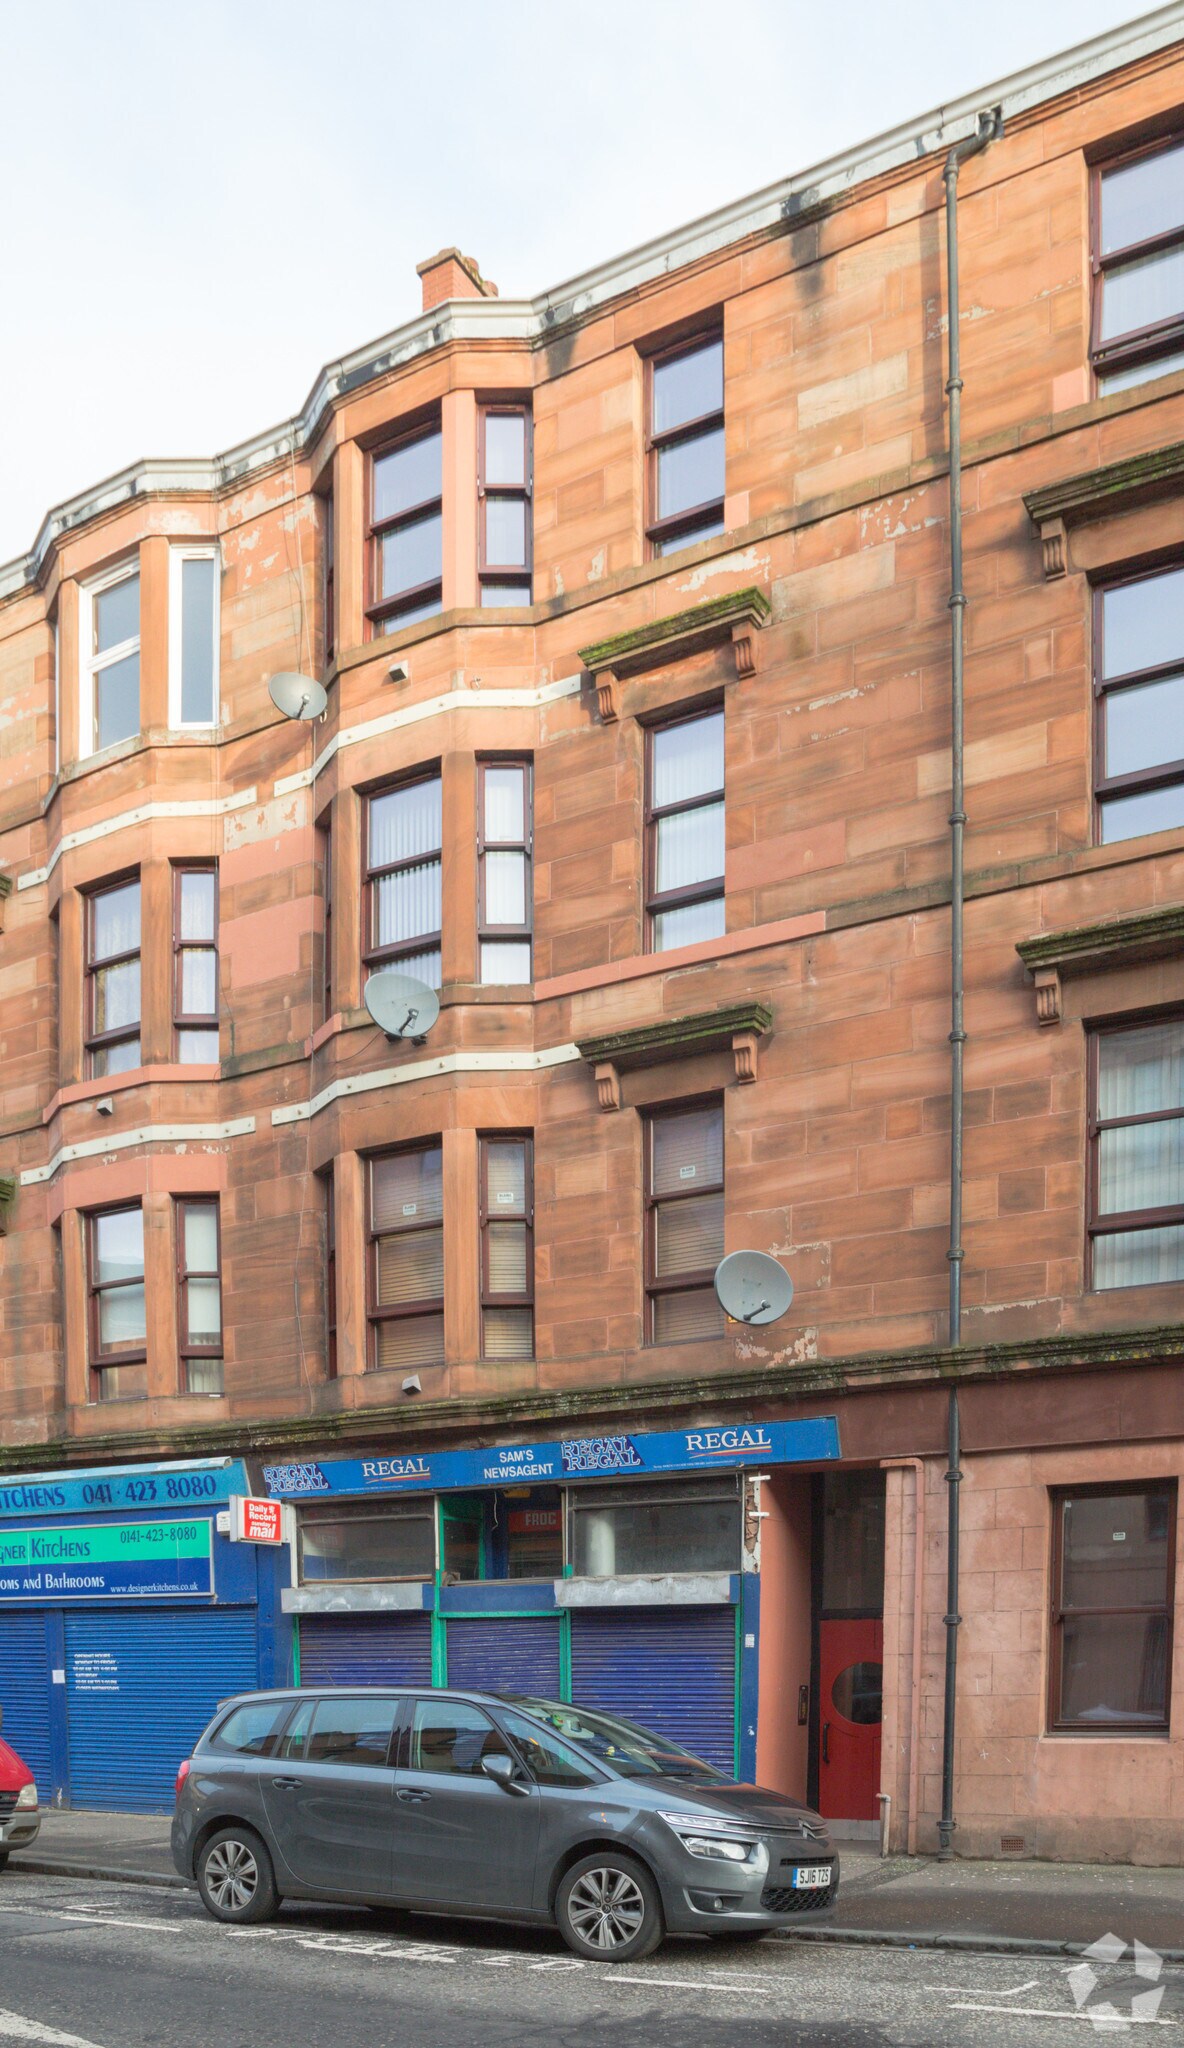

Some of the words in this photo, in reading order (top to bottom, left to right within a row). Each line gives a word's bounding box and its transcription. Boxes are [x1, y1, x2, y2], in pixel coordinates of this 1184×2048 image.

[685, 1429, 772, 1451] REGAL
[499, 1449, 534, 1463] SAM'S
[566, 1449, 641, 1471] REGAL
[362, 1458, 430, 1477] REGAL
[483, 1463, 554, 1479] NEWSAGENT
[82, 1483, 113, 1505] 041
[125, 1479, 157, 1502] 423
[166, 1475, 217, 1499] 8080
[248, 1503, 268, 1514] Daily
[249, 1511, 277, 1522] Record
[249, 1523, 277, 1539] mail
[251, 1521, 272, 1529] sunday
[119, 1526, 197, 1544] 0141-423-8080
[110, 1581, 199, 1594] www.designerkitchens.co.uk
[799, 1869, 816, 1884] SJ16
[818, 1868, 829, 1882] TZS
